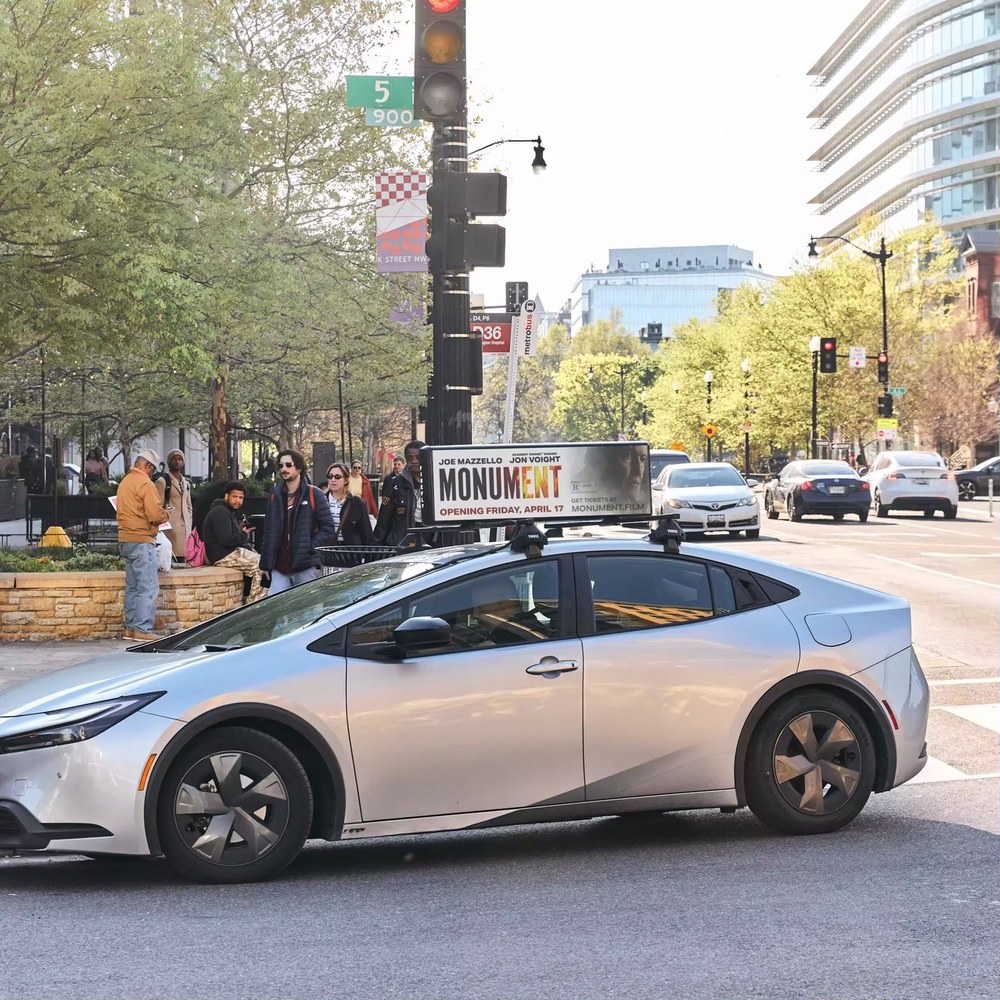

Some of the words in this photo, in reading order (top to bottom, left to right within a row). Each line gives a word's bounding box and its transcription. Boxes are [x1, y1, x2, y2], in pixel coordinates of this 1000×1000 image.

[375, 80, 390, 103] 5
[373, 109, 413, 125] 900
[458, 457, 502, 465] MAZZELLO
[510, 456, 527, 464] JON
[439, 465, 561, 501] MONUMENT
[440, 507, 484, 516] OPENING
[486, 506, 522, 514] FRIDAY,
[571, 503, 645, 512] MONUMENT.FILM
